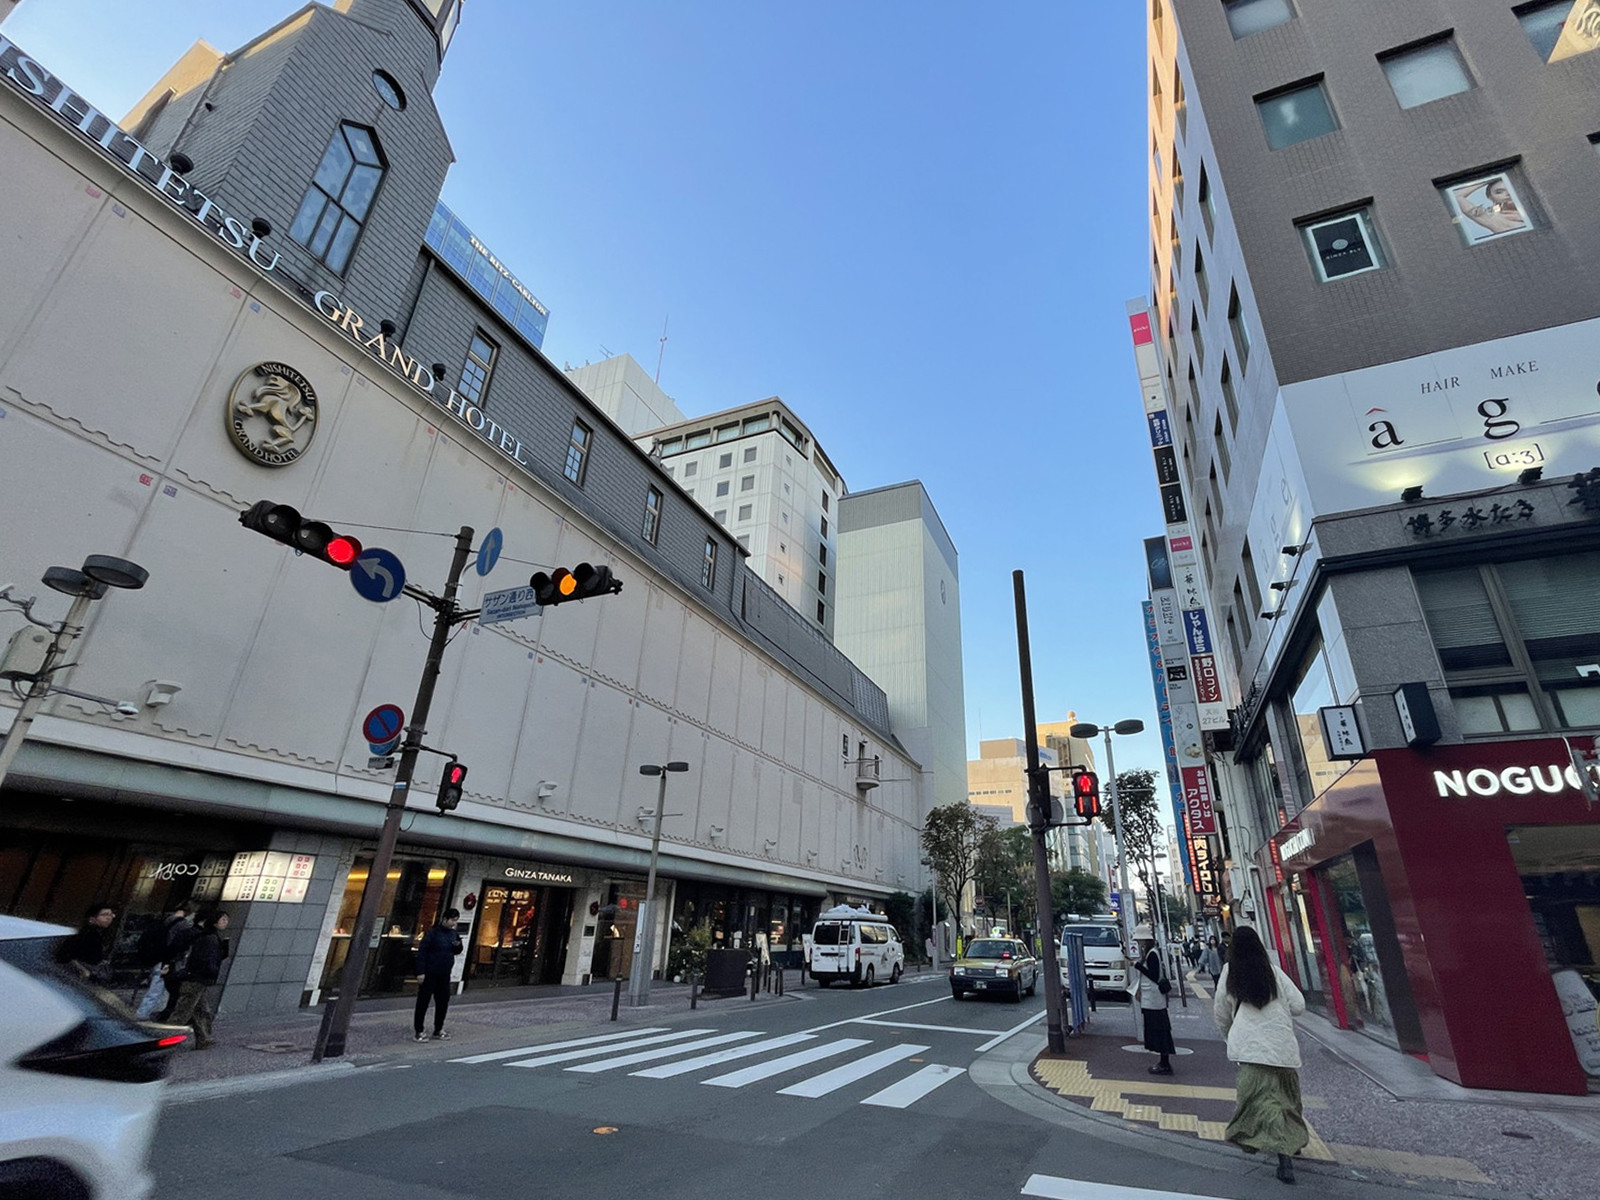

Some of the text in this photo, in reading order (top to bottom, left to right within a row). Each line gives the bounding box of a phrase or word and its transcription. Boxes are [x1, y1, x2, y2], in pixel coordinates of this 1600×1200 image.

[262, 363, 315, 401] NISHITETSU
[314, 290, 435, 392] GRAND
[445, 388, 528, 465] HOTEL
[1420, 360, 1540, 395] HAIR MAKE
[234, 420, 300, 464] GRAND HOTEL
[1433, 764, 1600, 797] NOGUC
[1187, 788, 1205, 830] アクタス
